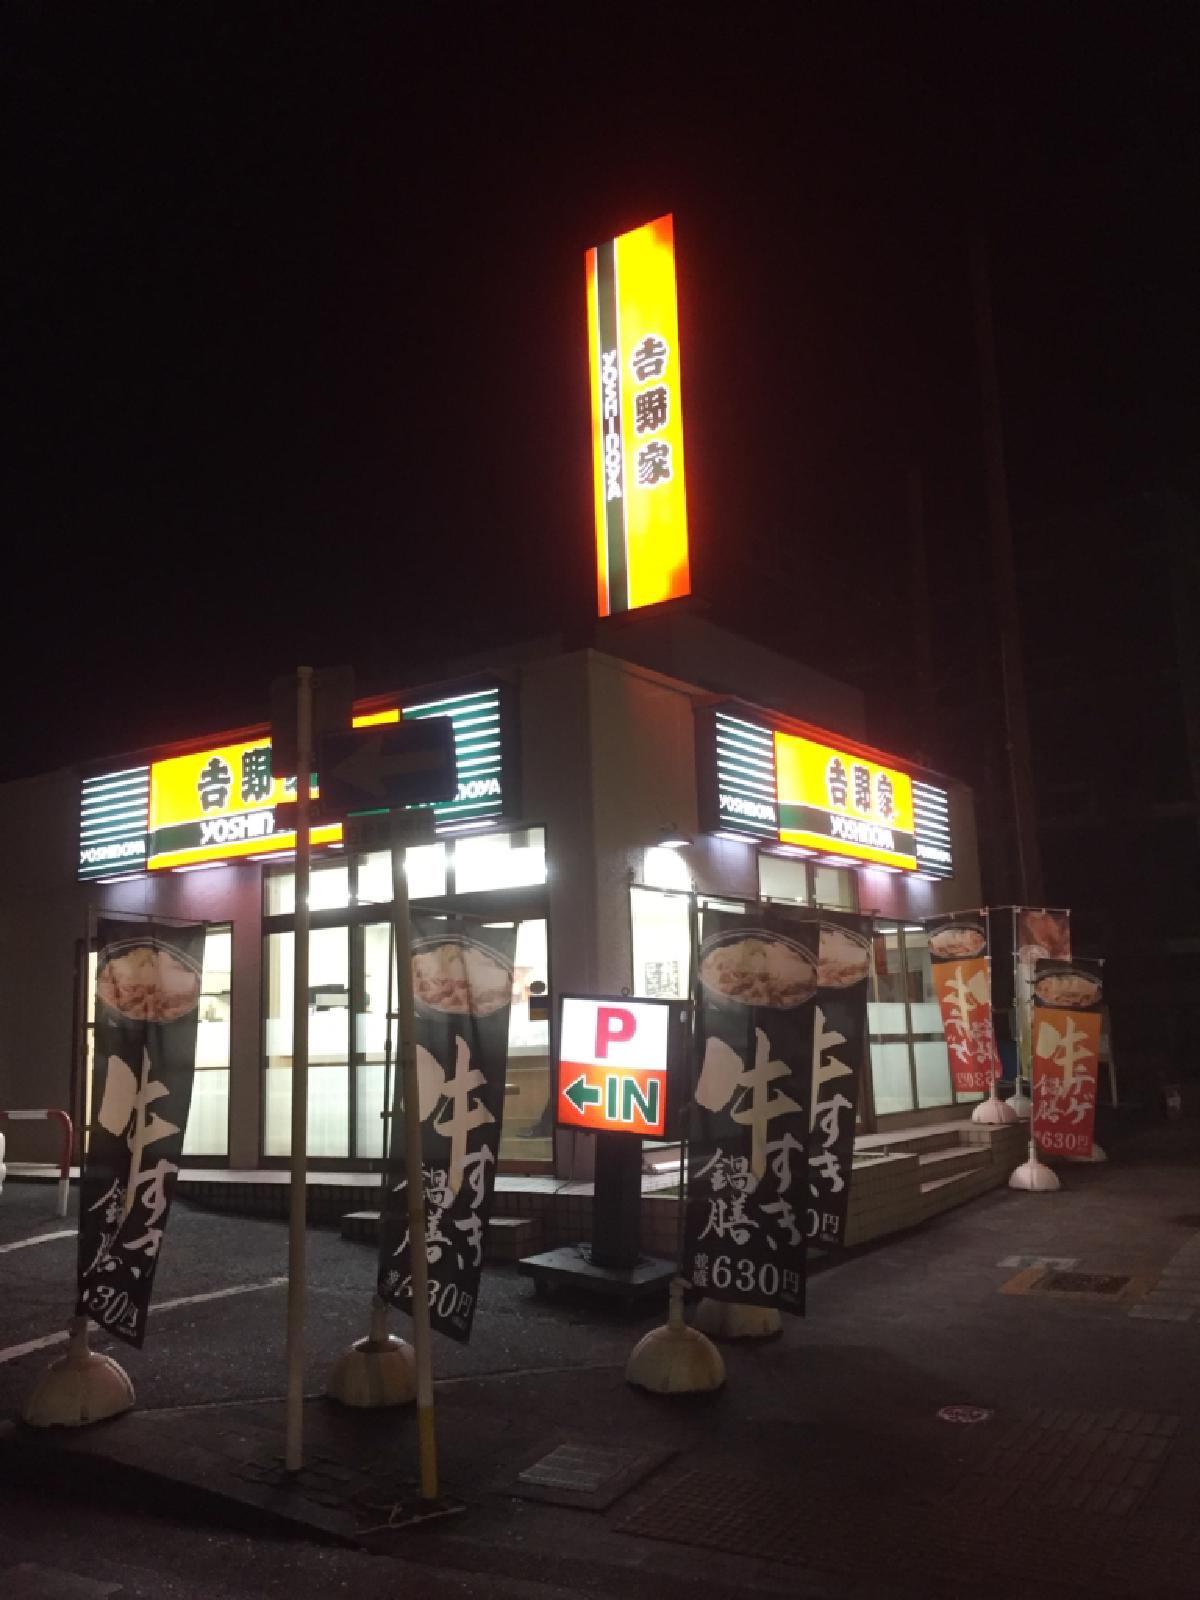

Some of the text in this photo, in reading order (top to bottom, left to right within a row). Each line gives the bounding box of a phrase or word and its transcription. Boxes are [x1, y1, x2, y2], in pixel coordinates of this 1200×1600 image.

[632, 335, 672, 485] 吉野家
[828, 756, 894, 820] 吉野家
[201, 812, 275, 844] YOSHIN
[595, 1006, 637, 1058] P
[606, 1075, 660, 1126] IN
[695, 1027, 803, 1251] 牛すき
[712, 1255, 799, 1296] 630円
